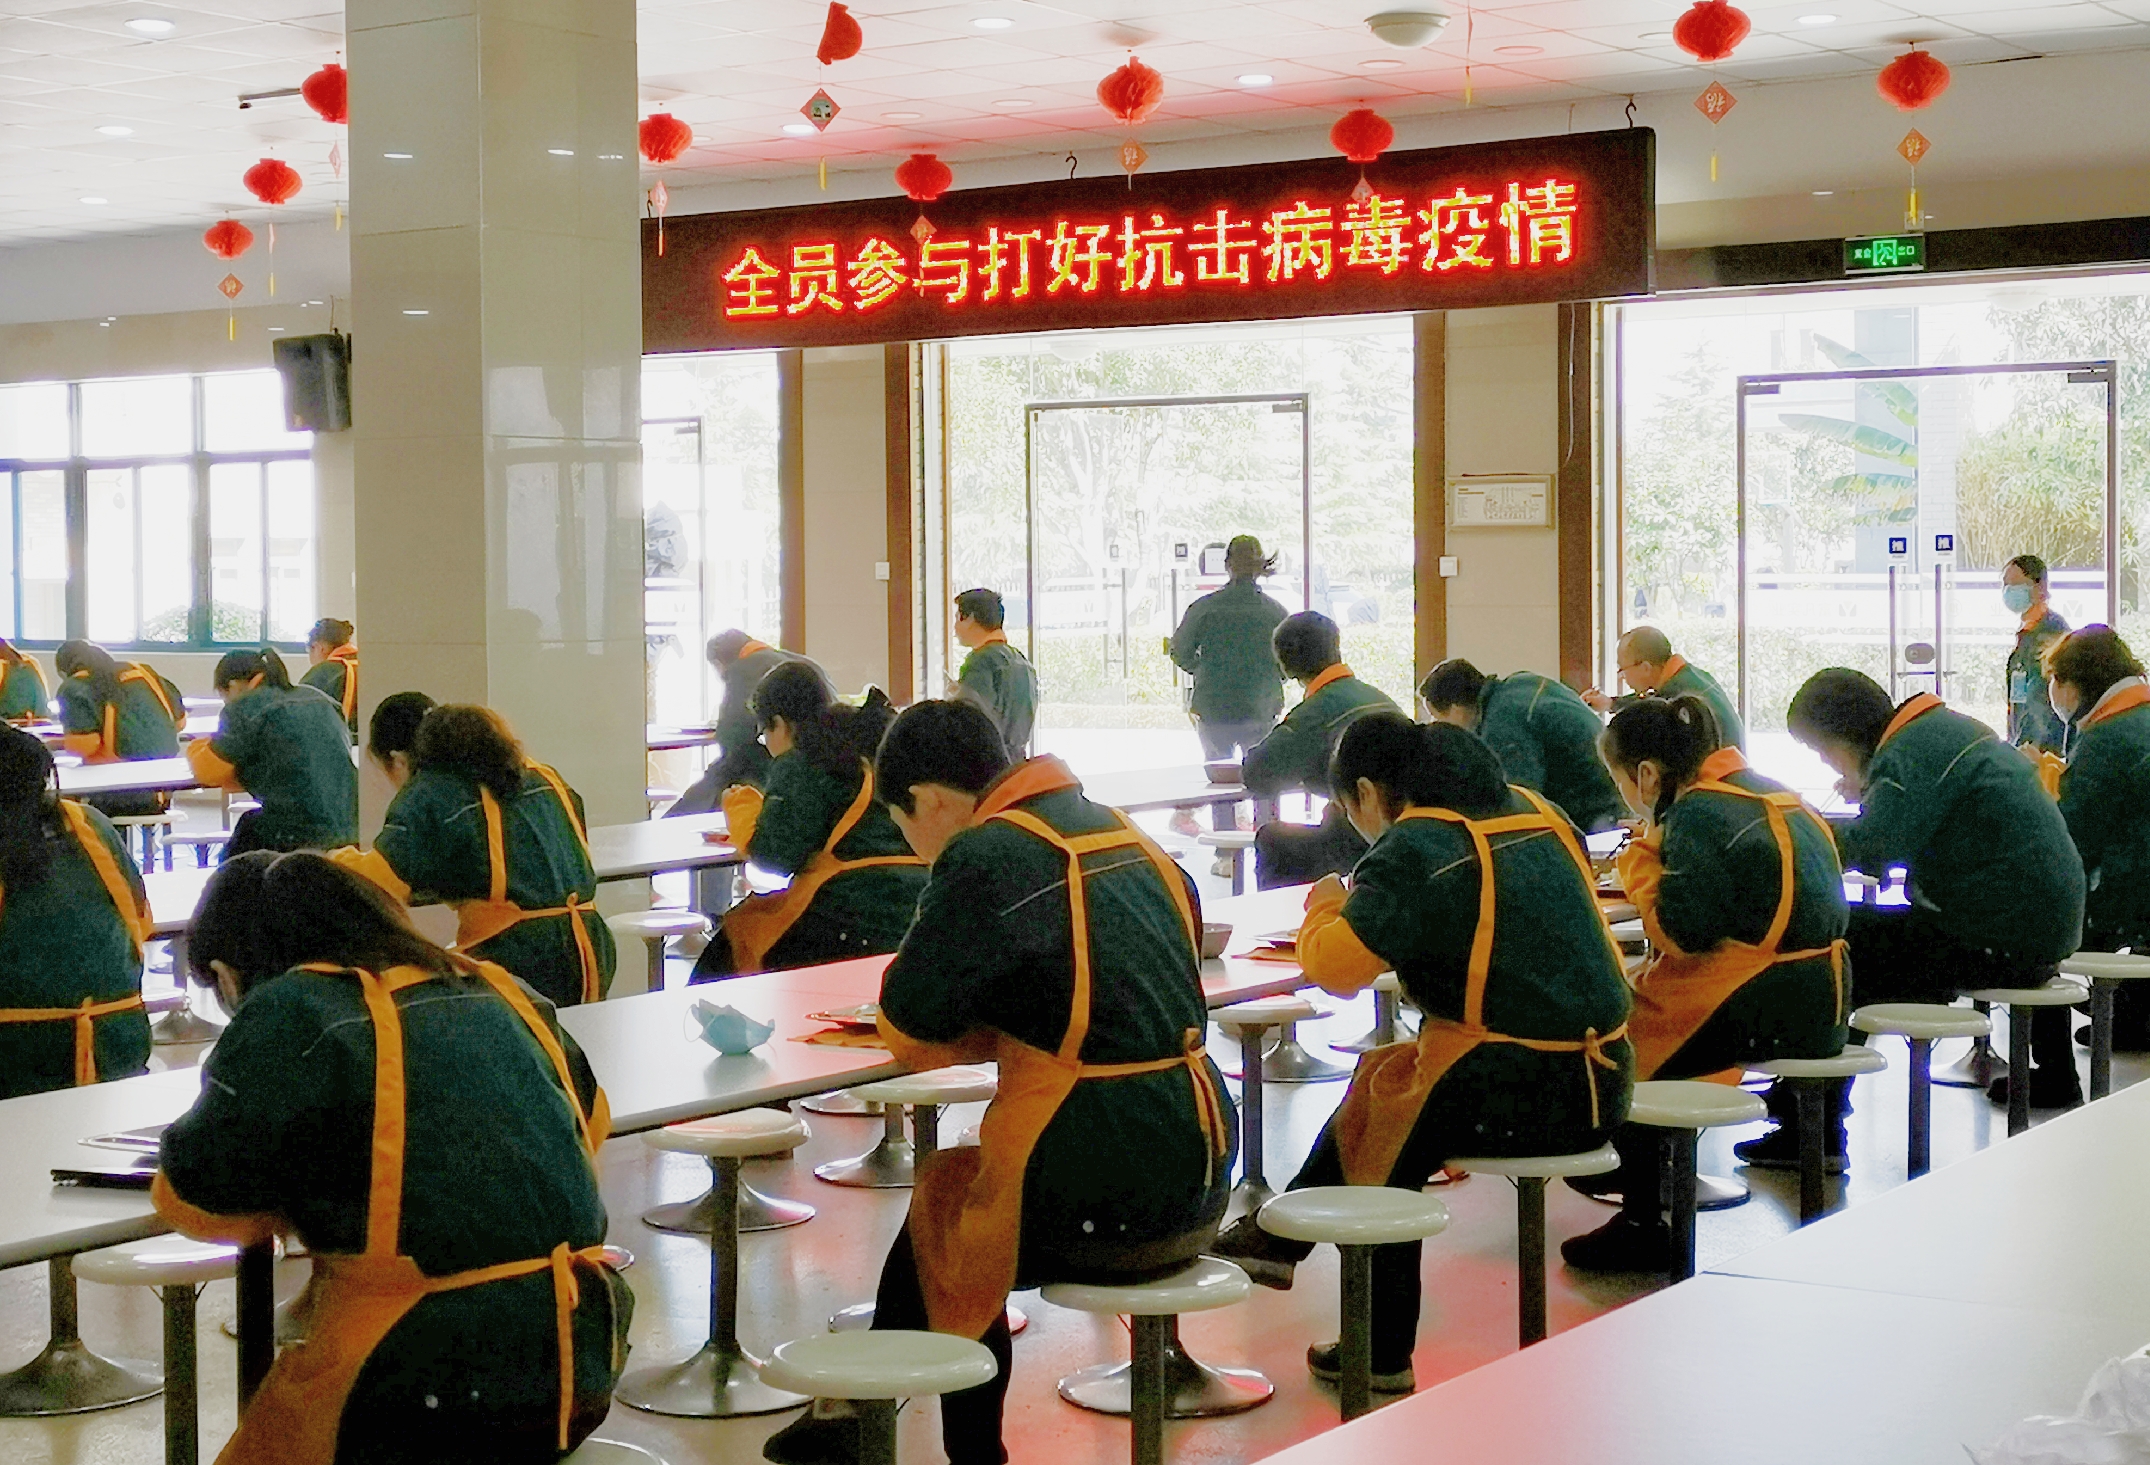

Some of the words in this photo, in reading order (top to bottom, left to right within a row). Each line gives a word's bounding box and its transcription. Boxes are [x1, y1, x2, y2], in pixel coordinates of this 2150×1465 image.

[723, 179, 1577, 316] 全员参与打好抗击病毒疫情
